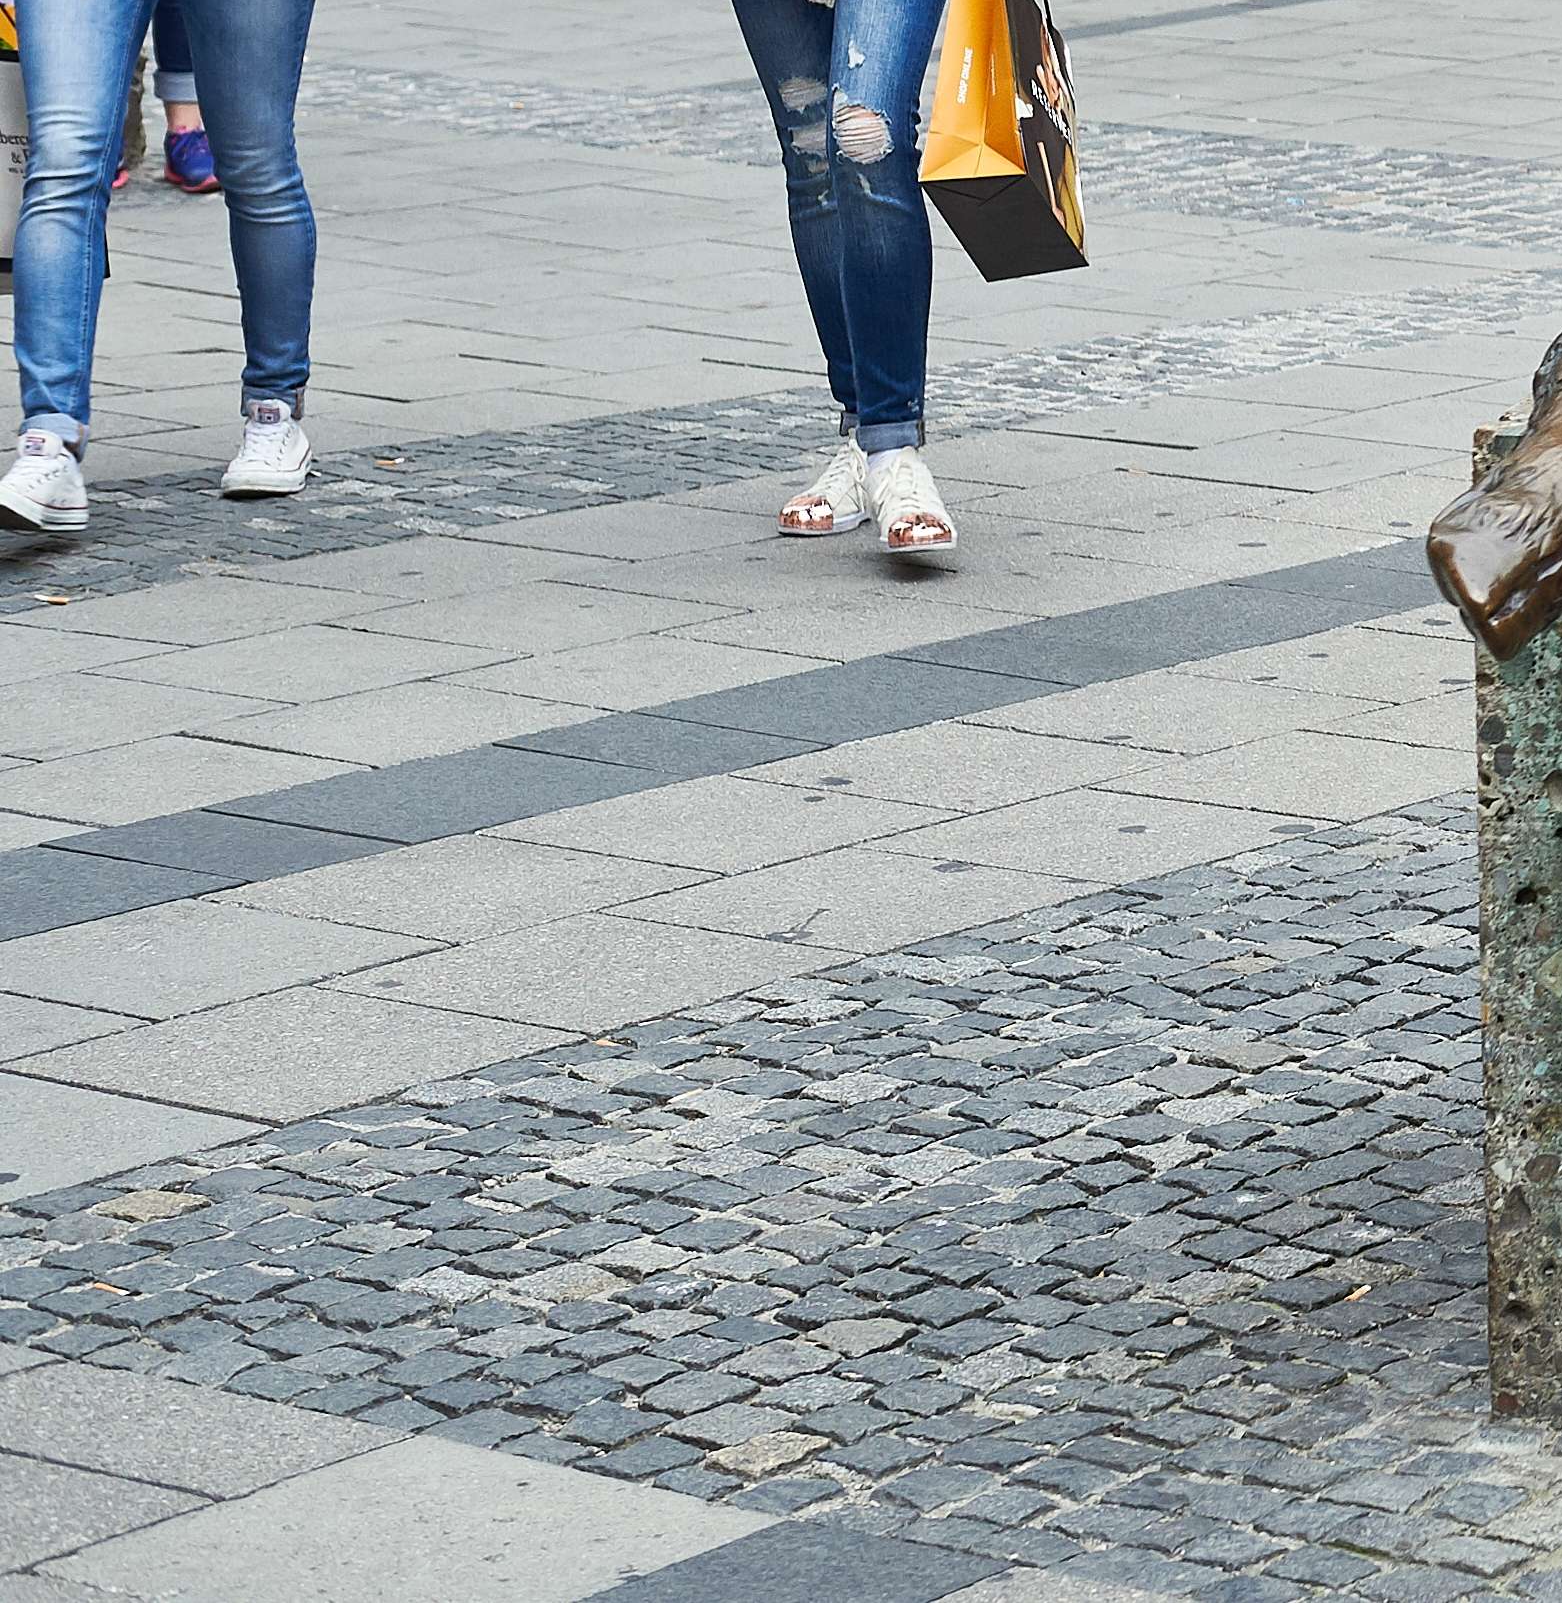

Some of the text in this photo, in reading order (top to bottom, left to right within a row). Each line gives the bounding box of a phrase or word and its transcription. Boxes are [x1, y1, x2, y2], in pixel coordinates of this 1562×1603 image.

[957, 47, 973, 104] SHOP ONLINE
[1031, 79, 1073, 146] RESERVED
